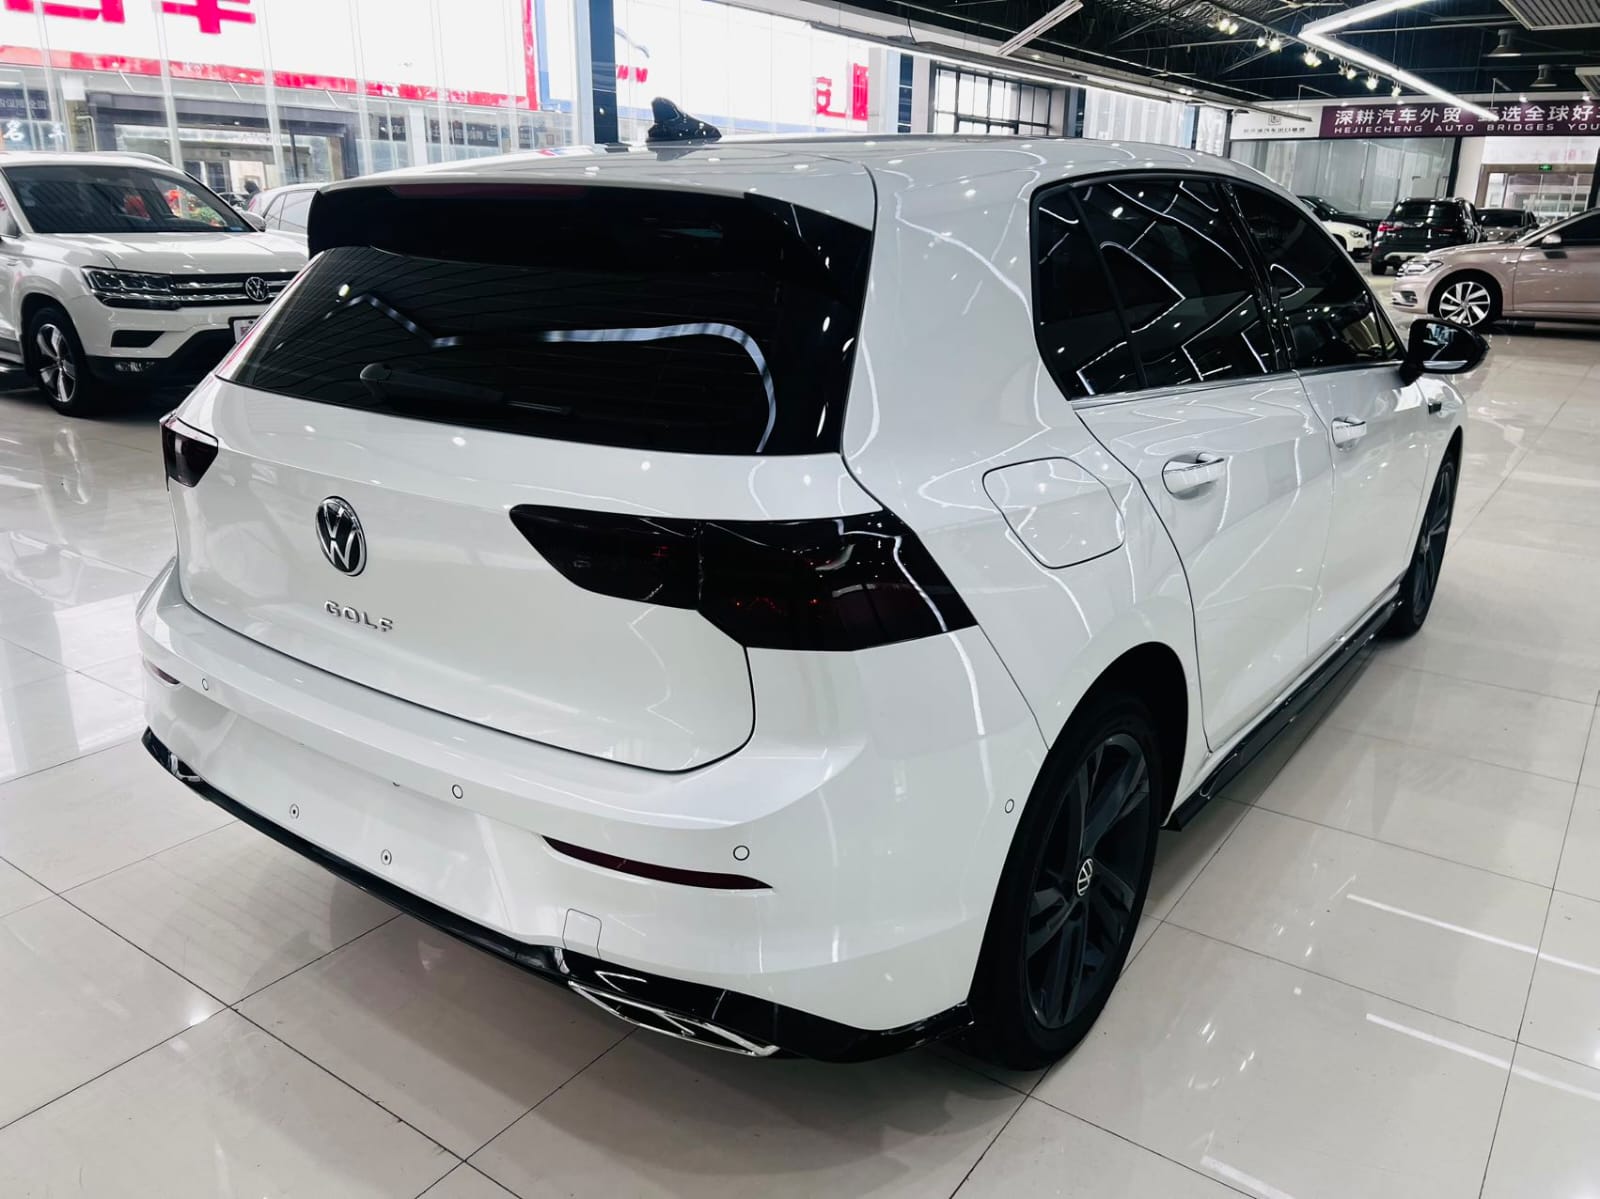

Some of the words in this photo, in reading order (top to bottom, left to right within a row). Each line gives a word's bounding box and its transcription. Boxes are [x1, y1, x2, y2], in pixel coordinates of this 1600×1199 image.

[1334, 107, 1461, 125] 深耕汽车外贸
[1334, 125, 1423, 134] HEJIECHENG
[1434, 124, 1474, 133] AUTO
[1487, 123, 1555, 132] BRIDGES
[324, 600, 393, 632] GOLF
